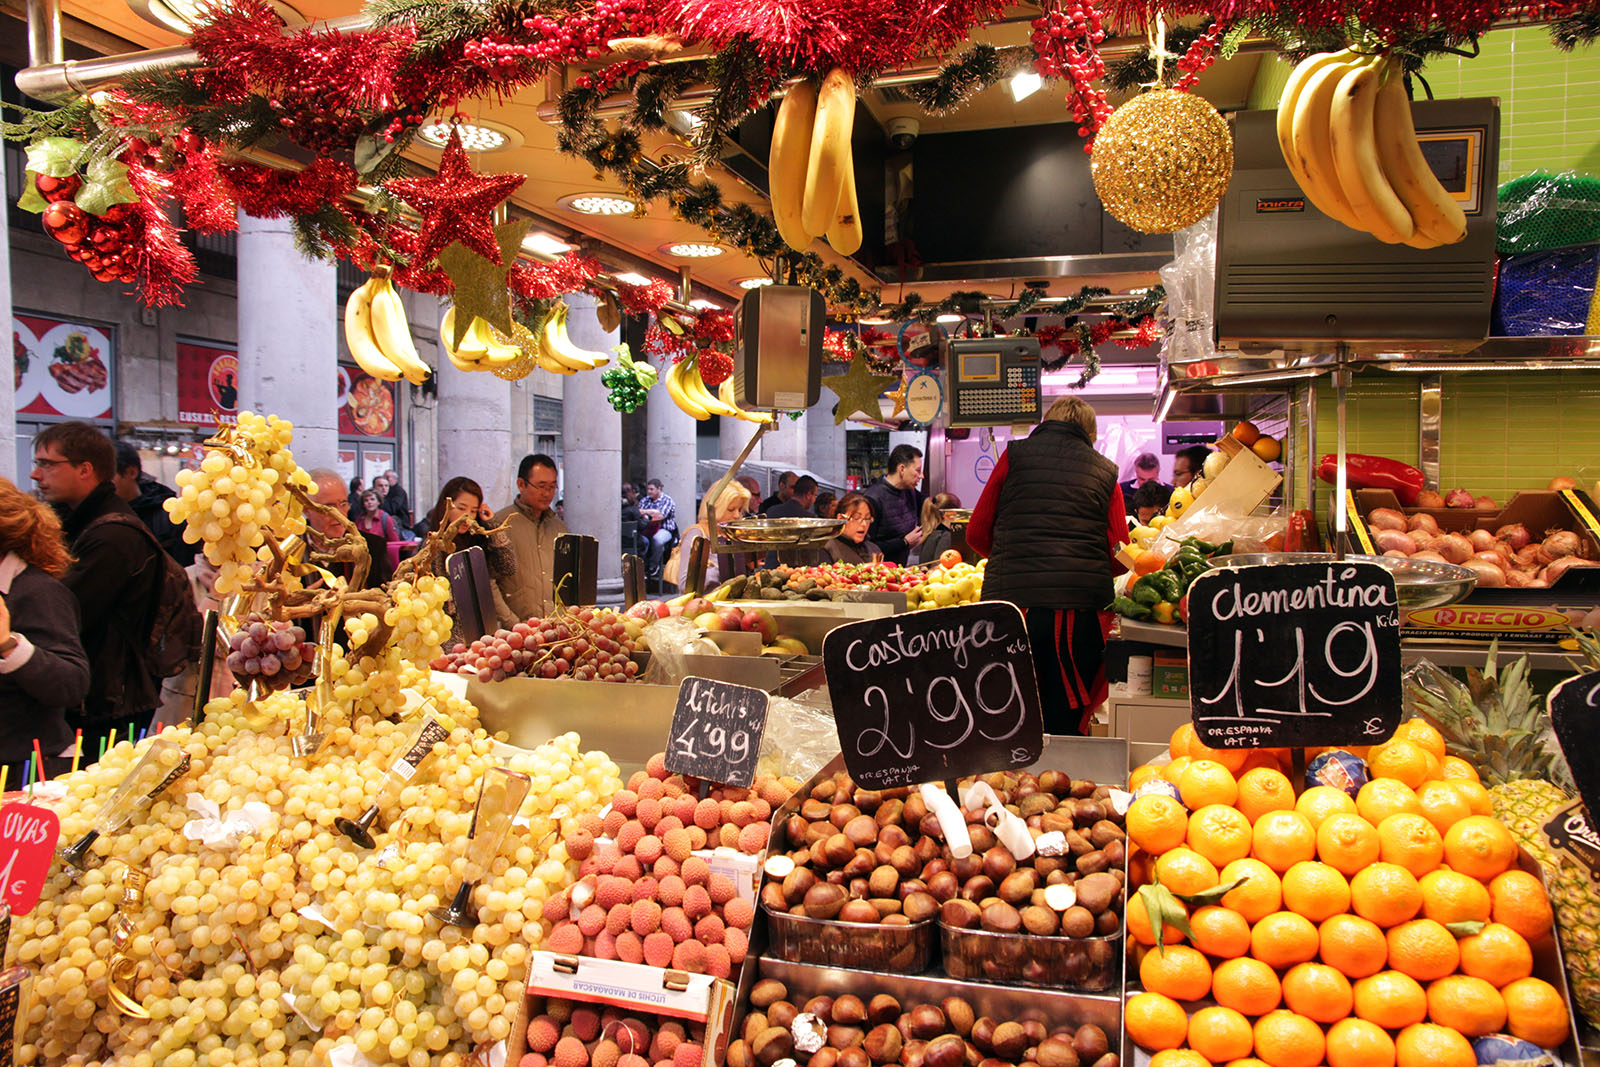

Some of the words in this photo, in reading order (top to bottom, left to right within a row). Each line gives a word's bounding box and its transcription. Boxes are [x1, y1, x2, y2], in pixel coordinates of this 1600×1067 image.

[1459, 611, 1545, 626] RECIO
[846, 619, 1008, 671] Castanya
[1199, 621, 1379, 723] 1'19
[856, 662, 1025, 759] 2'99
[3, 812, 51, 844] UVAS
[573, 983, 626, 997] MADAGASCAR
[628, 991, 637, 999] DE
